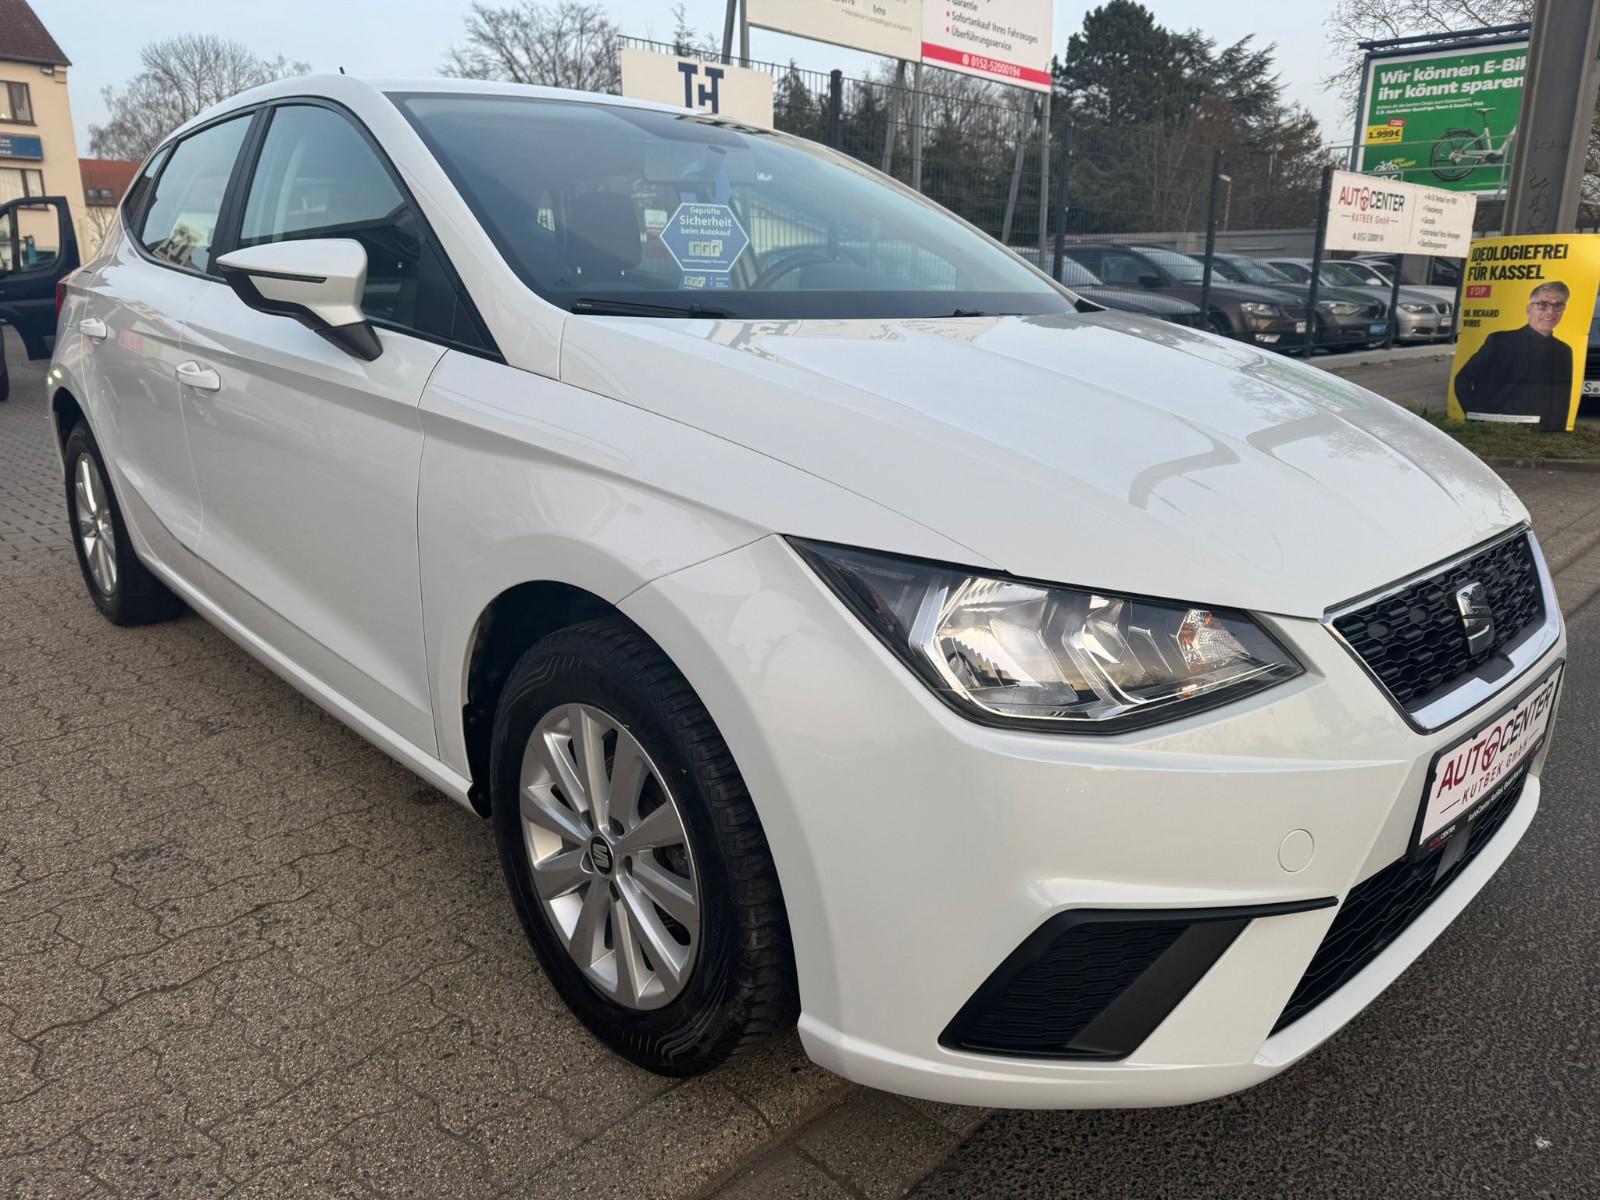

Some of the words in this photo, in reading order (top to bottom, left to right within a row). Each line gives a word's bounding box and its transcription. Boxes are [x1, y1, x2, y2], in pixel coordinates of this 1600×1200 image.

[951, 10, 991, 31] Sofortankauf
[1380, 70, 1411, 85] Wir
[1413, 65, 1480, 82] können
[1377, 86, 1403, 101] ihr
[1405, 81, 1459, 98] könnt
[689, 206, 720, 215] Geprüfte
[679, 215, 732, 228] Sicherheit
[699, 228, 731, 237] Autokauf
[1471, 244, 1568, 262] IDEOLOGIEFREI
[1467, 262, 1488, 281] FÜR
[1489, 264, 1545, 280] KASSEL
[1461, 760, 1503, 805] KUTBEK
